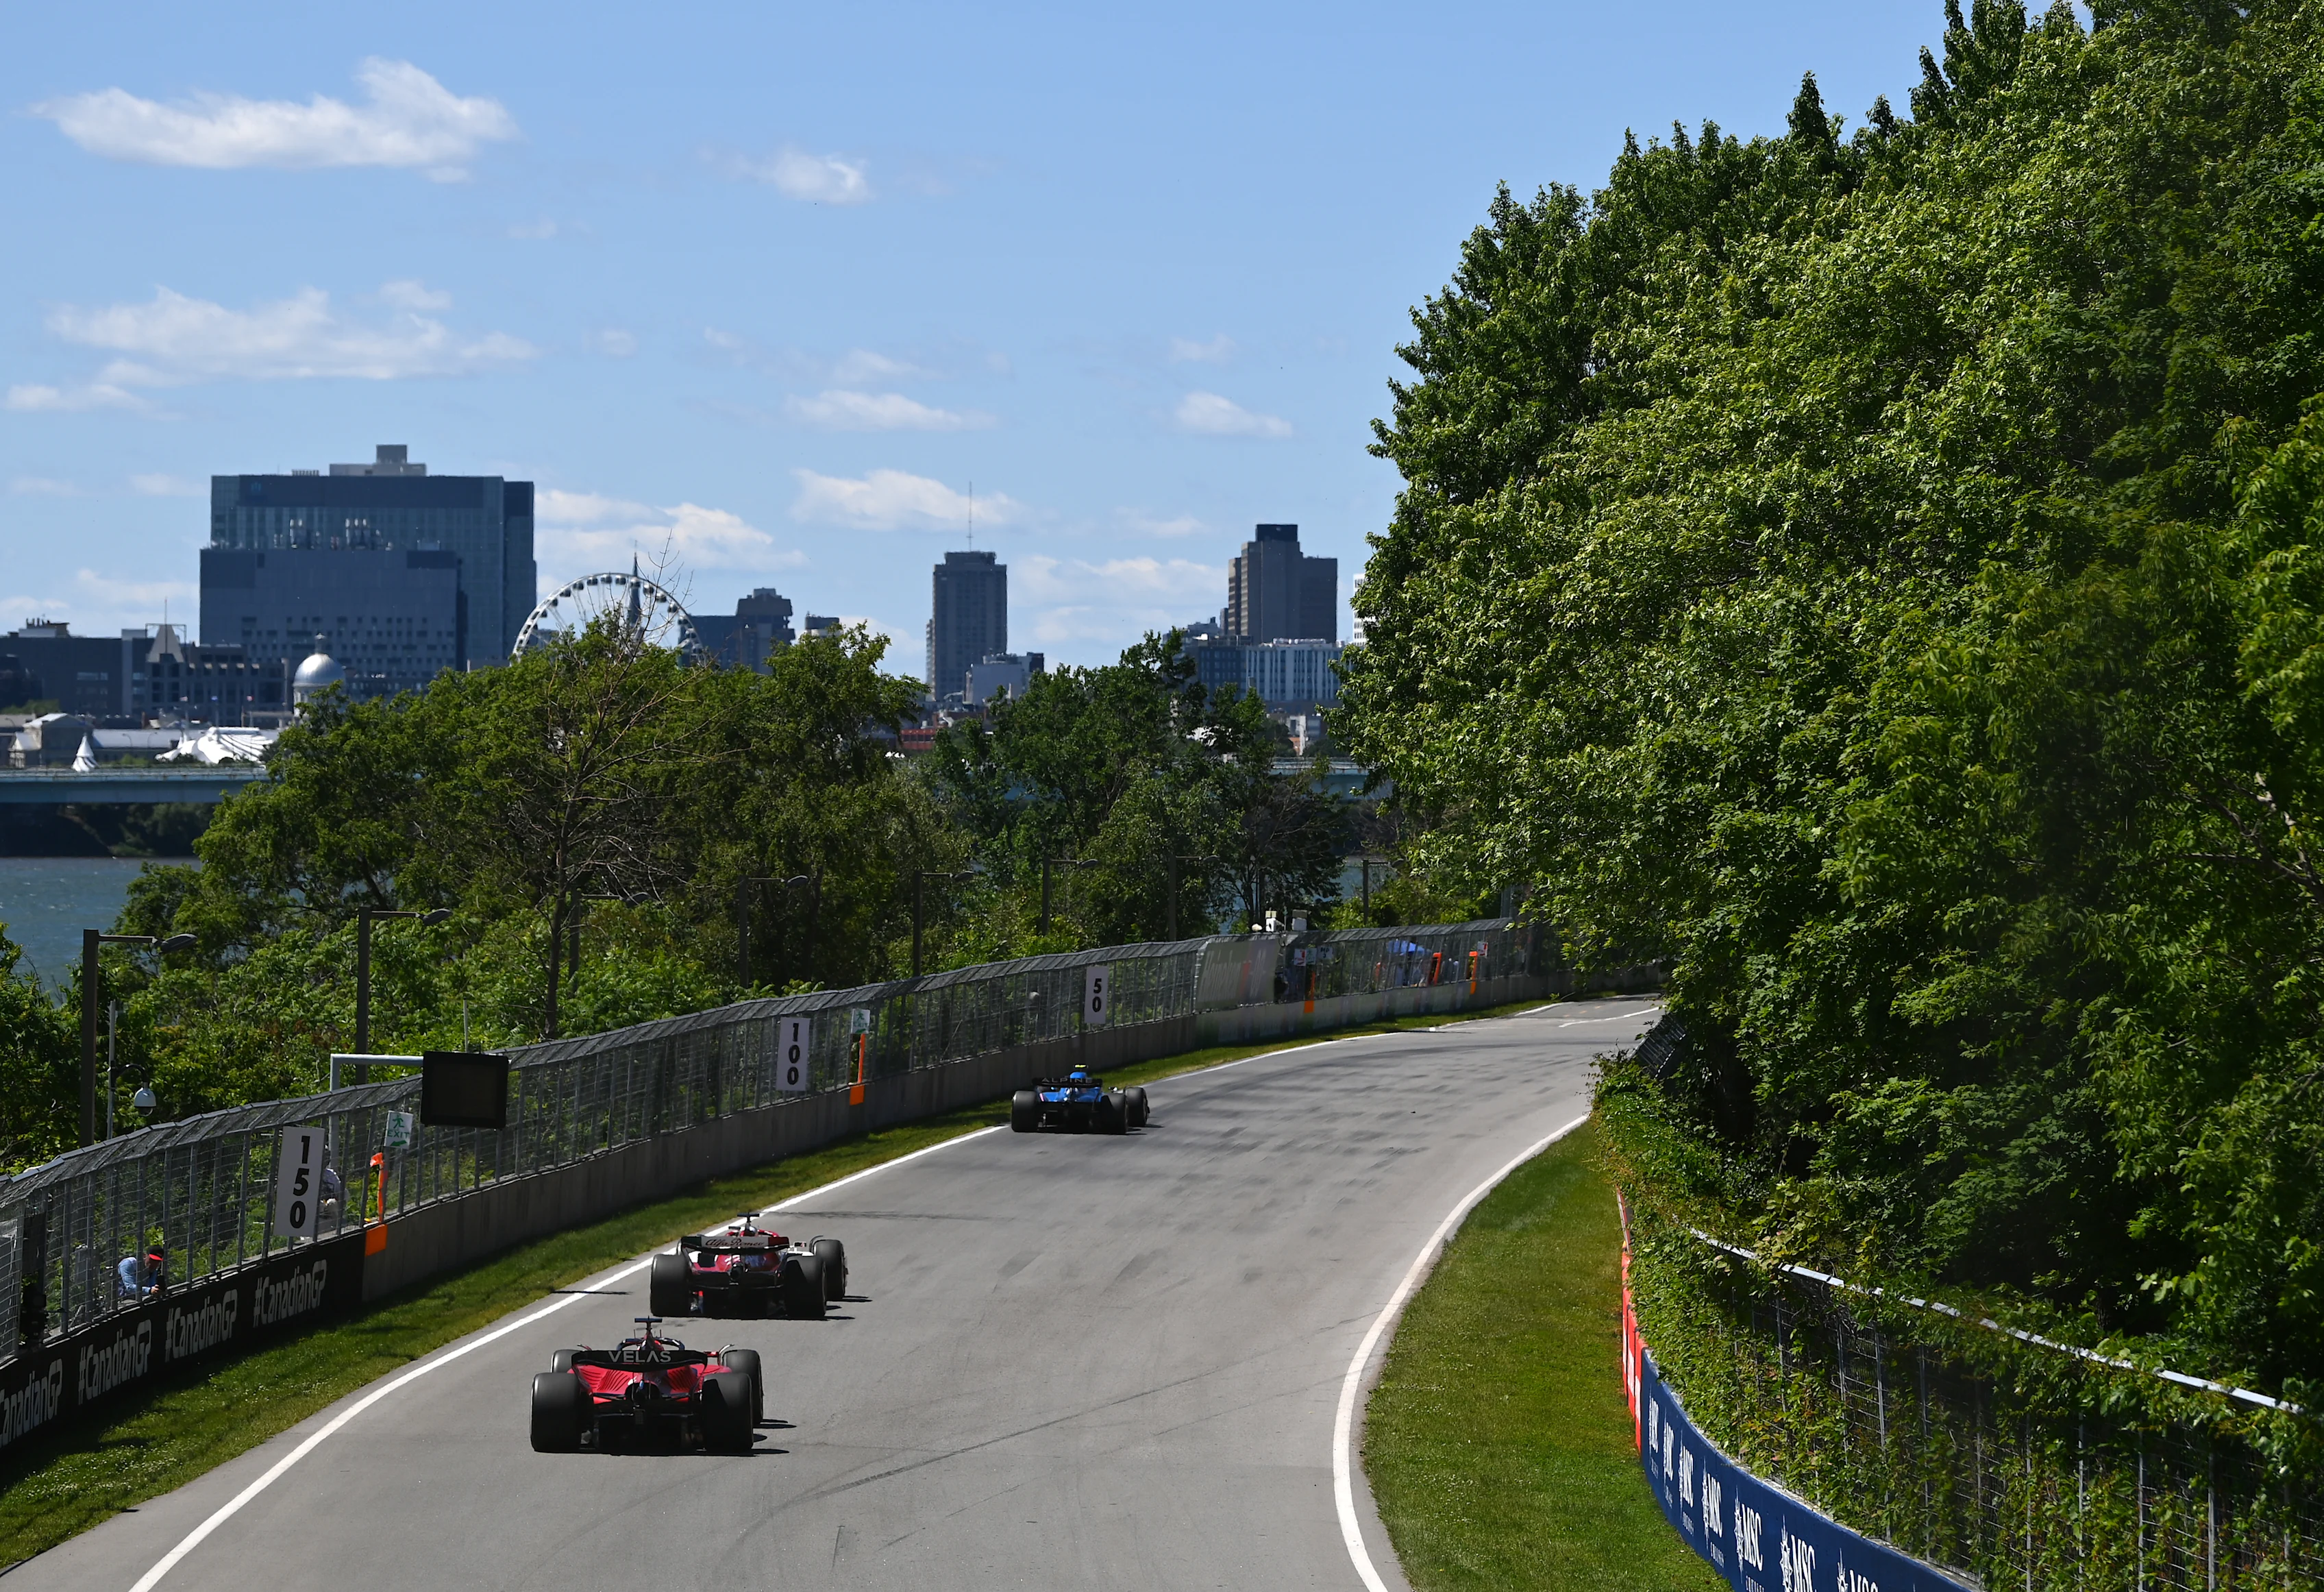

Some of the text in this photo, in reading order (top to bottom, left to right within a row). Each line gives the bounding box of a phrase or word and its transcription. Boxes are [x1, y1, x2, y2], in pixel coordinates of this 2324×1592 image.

[1092, 978, 1102, 1012] 50
[787, 1022, 800, 1085] 100
[387, 1129, 410, 1138] EXIT
[290, 1135, 310, 1229] 150
[705, 1237, 766, 1247] Alfa Romeo
[254, 1259, 327, 1327] #CanadianGP
[164, 1289, 238, 1362] #CanadianGP
[608, 1351, 671, 1363] VELAS
[78, 1319, 151, 1405] #CanadianGP
[1707, 1473, 1723, 1538] MSC
[1742, 1504, 1764, 1571] MSC
[1790, 1534, 1816, 1592] MSC
